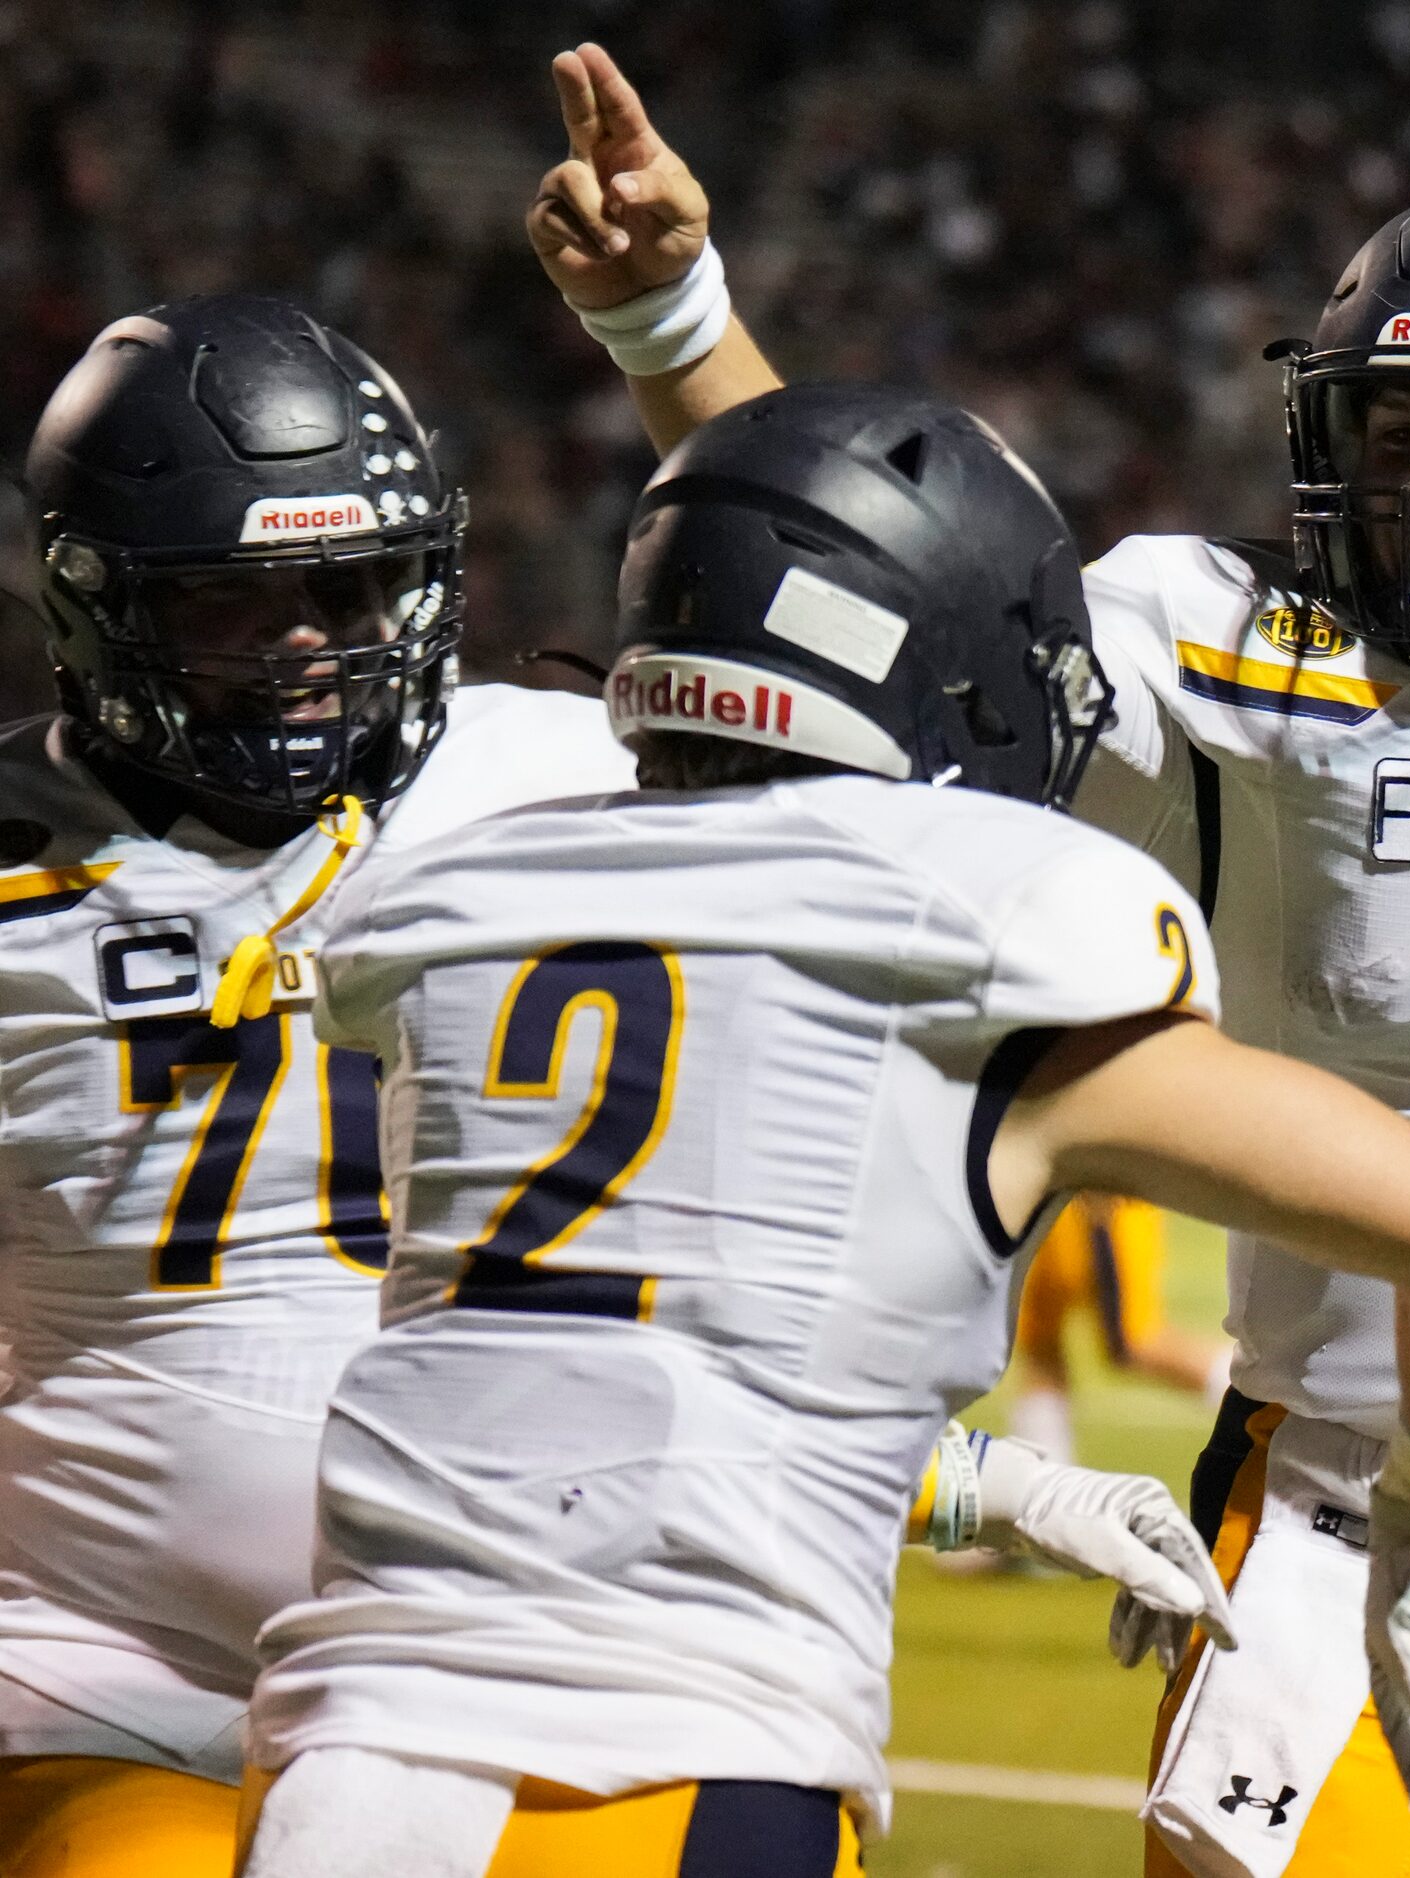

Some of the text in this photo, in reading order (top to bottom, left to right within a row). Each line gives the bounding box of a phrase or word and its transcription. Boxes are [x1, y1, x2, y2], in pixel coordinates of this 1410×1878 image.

[262, 506, 362, 529] Riddell
[614, 671, 793, 738] Riddell
[269, 736, 324, 751] Rddell
[101, 931, 198, 1006] C
[1153, 901, 1198, 1008] 2
[444, 941, 687, 1323] 2
